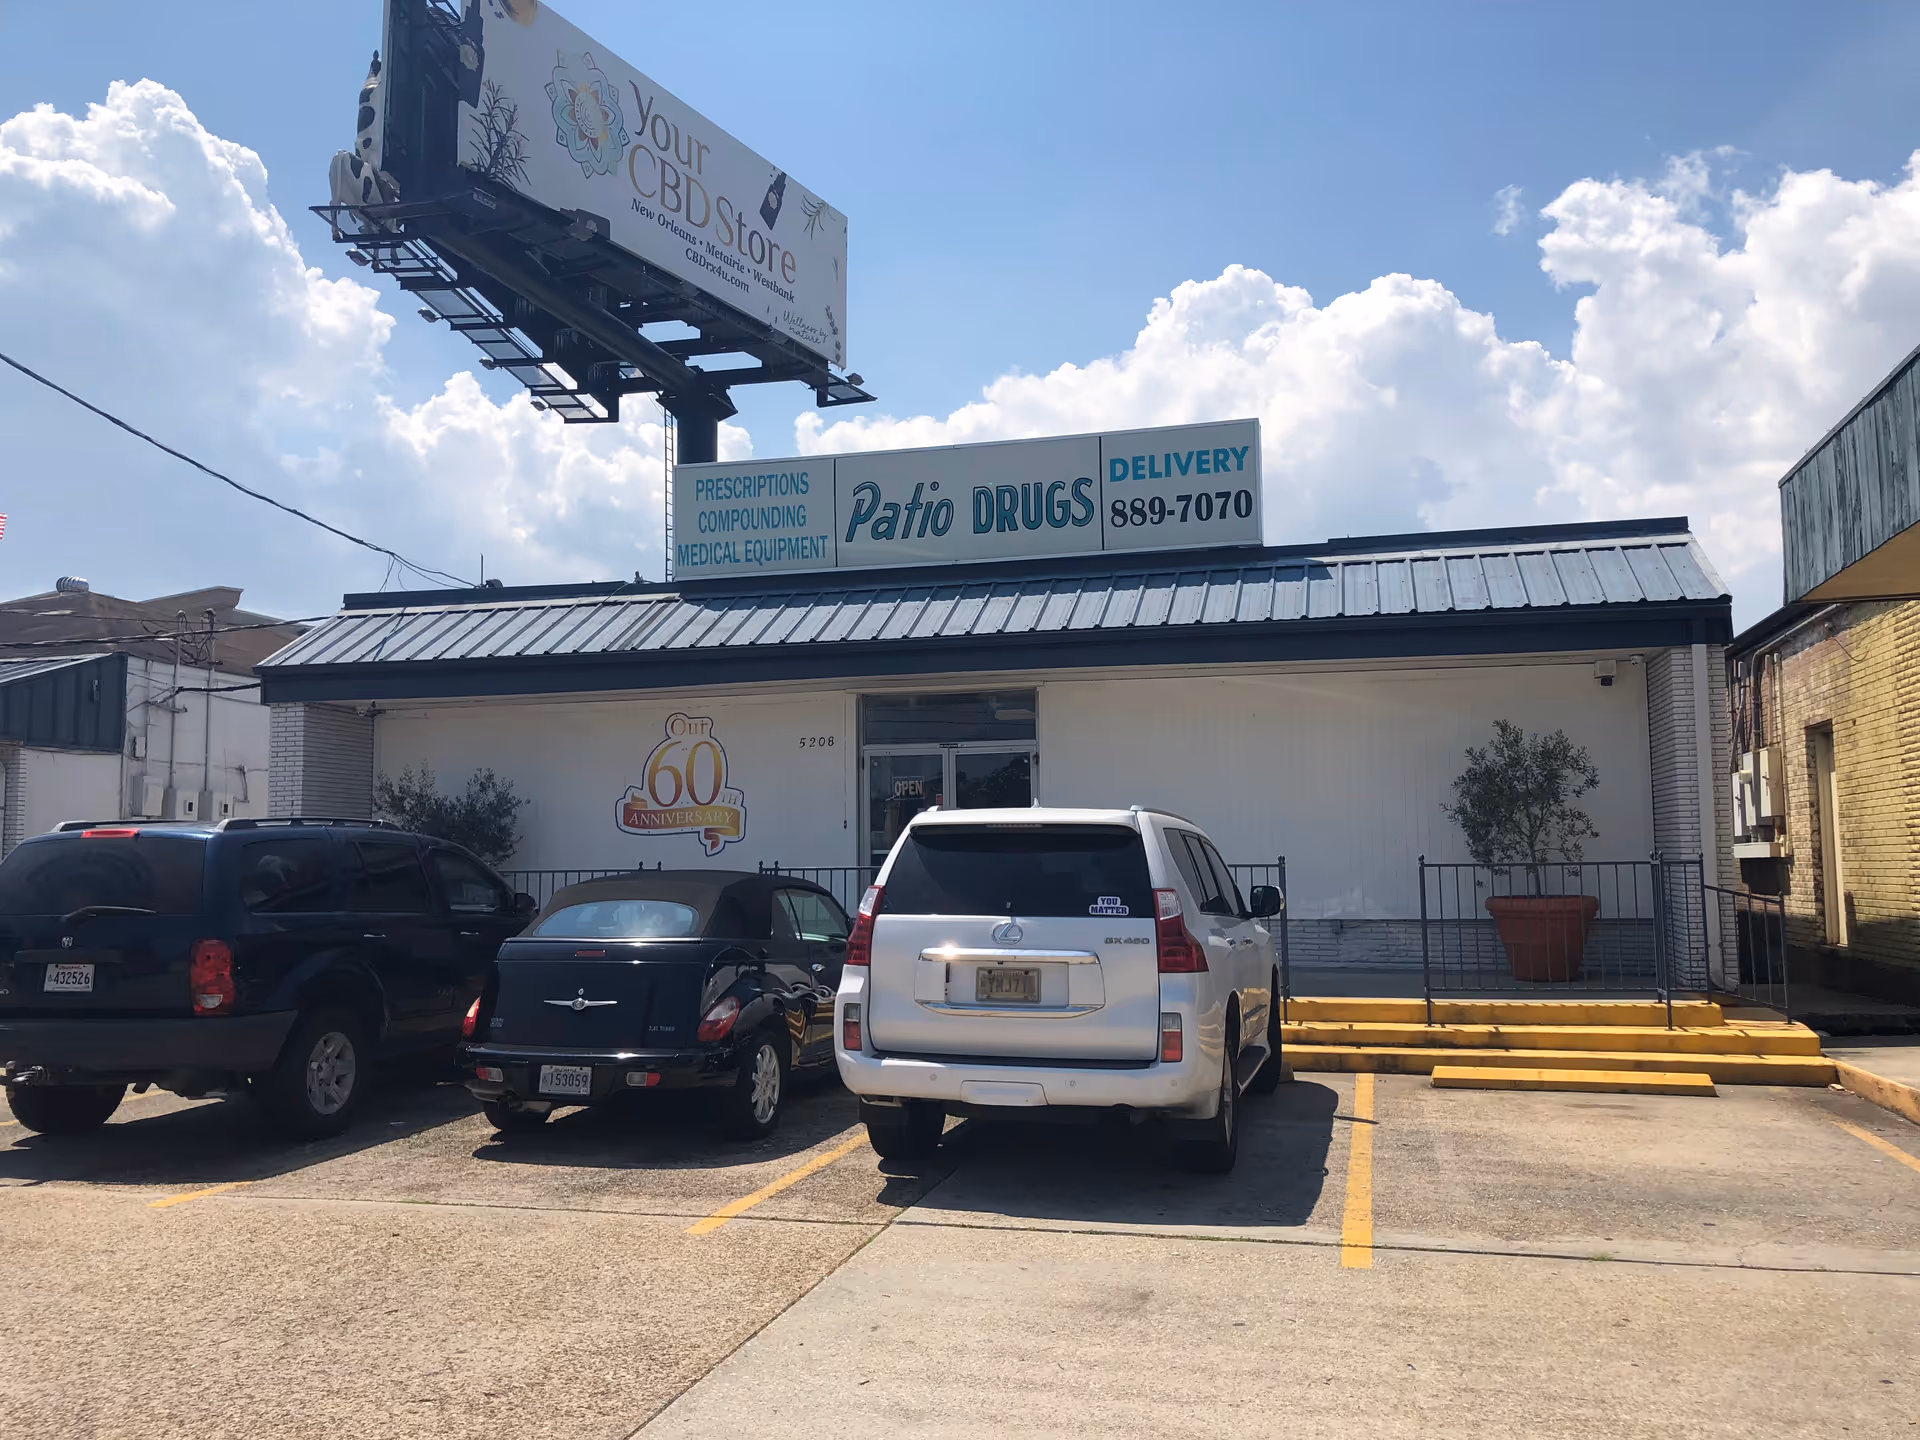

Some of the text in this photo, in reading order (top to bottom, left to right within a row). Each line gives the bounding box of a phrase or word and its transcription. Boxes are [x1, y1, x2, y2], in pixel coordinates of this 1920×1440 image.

[629, 80, 711, 175] Your
[631, 198, 795, 303] New Orleans Metairie Westbank
[685, 247, 750, 293] CBDrx4u.com
[789, 326, 821, 344] nature
[820, 328, 829, 343] by
[1109, 446, 1250, 482] DELIVERY
[695, 472, 809, 501] PRESCRIPTIONS
[698, 505, 807, 533] COMPOUNDING
[845, 478, 1094, 542] Patio DRUGS
[1111, 489, 1253, 527] 889-7070
[677, 535, 828, 566] MEDICAL EQUIPMENT
[799, 736, 834, 748] 5208
[894, 780, 923, 796] OPEN
[629, 810, 734, 826] ANNIVERSARY
[1090, 906, 1127, 914] MATTER
[1100, 897, 1118, 905] YOU
[53, 971, 90, 984] 432526
[550, 1073, 588, 1087] 153059
